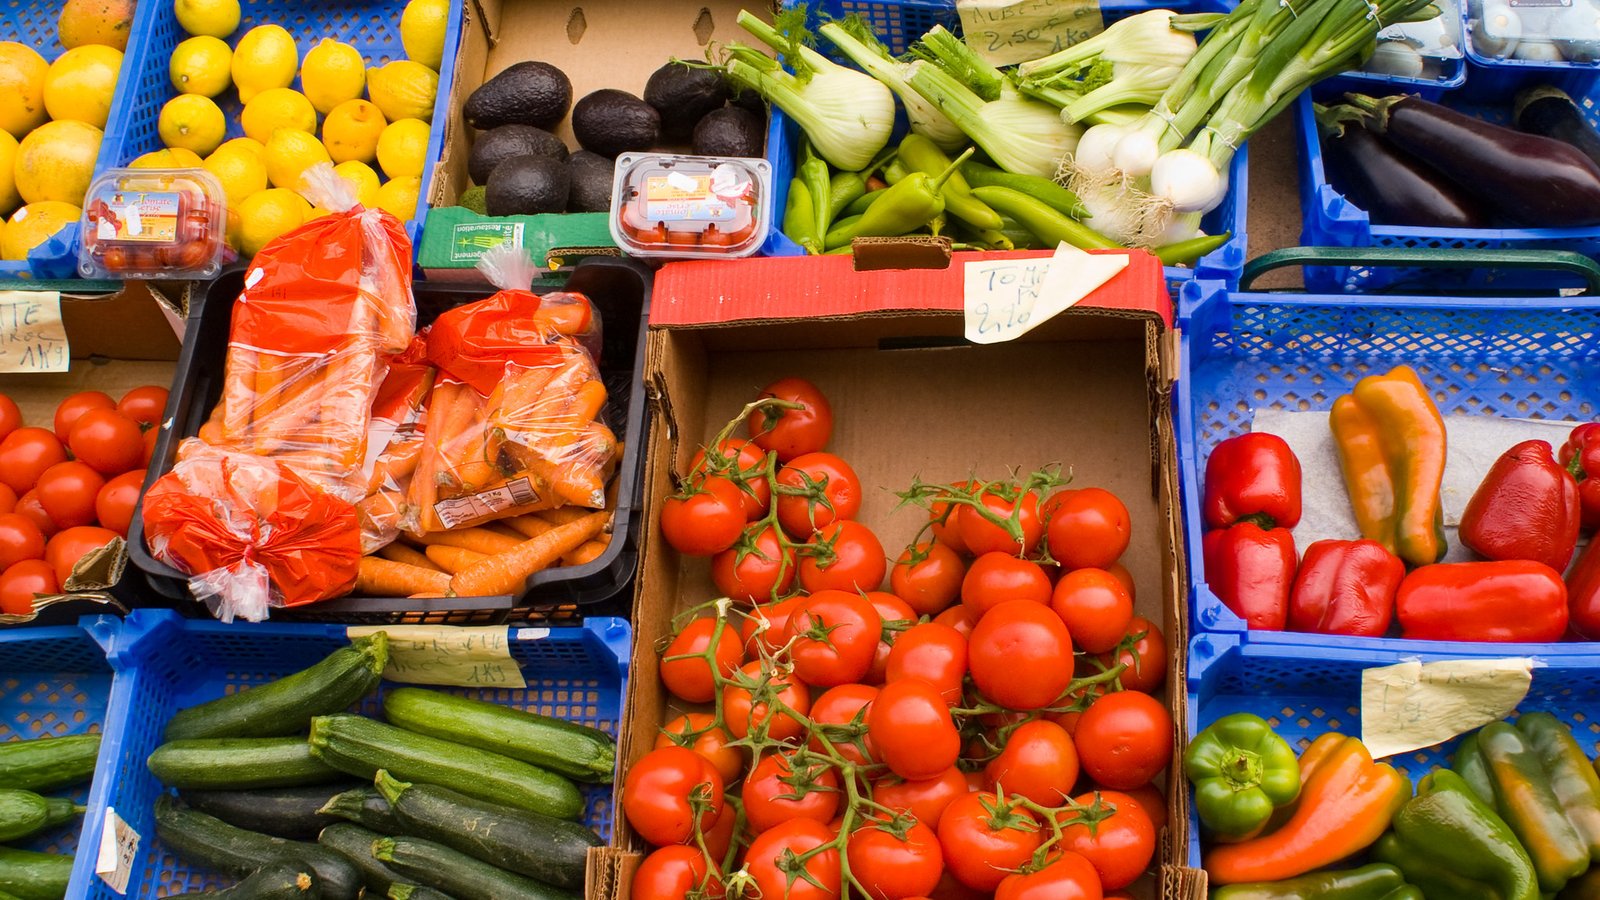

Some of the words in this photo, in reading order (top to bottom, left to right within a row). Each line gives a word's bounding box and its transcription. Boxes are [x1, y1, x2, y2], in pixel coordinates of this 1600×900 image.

[137, 193, 172, 205] Tomate
[137, 204, 161, 212] erise
[457, 224, 501, 233] Restauration
